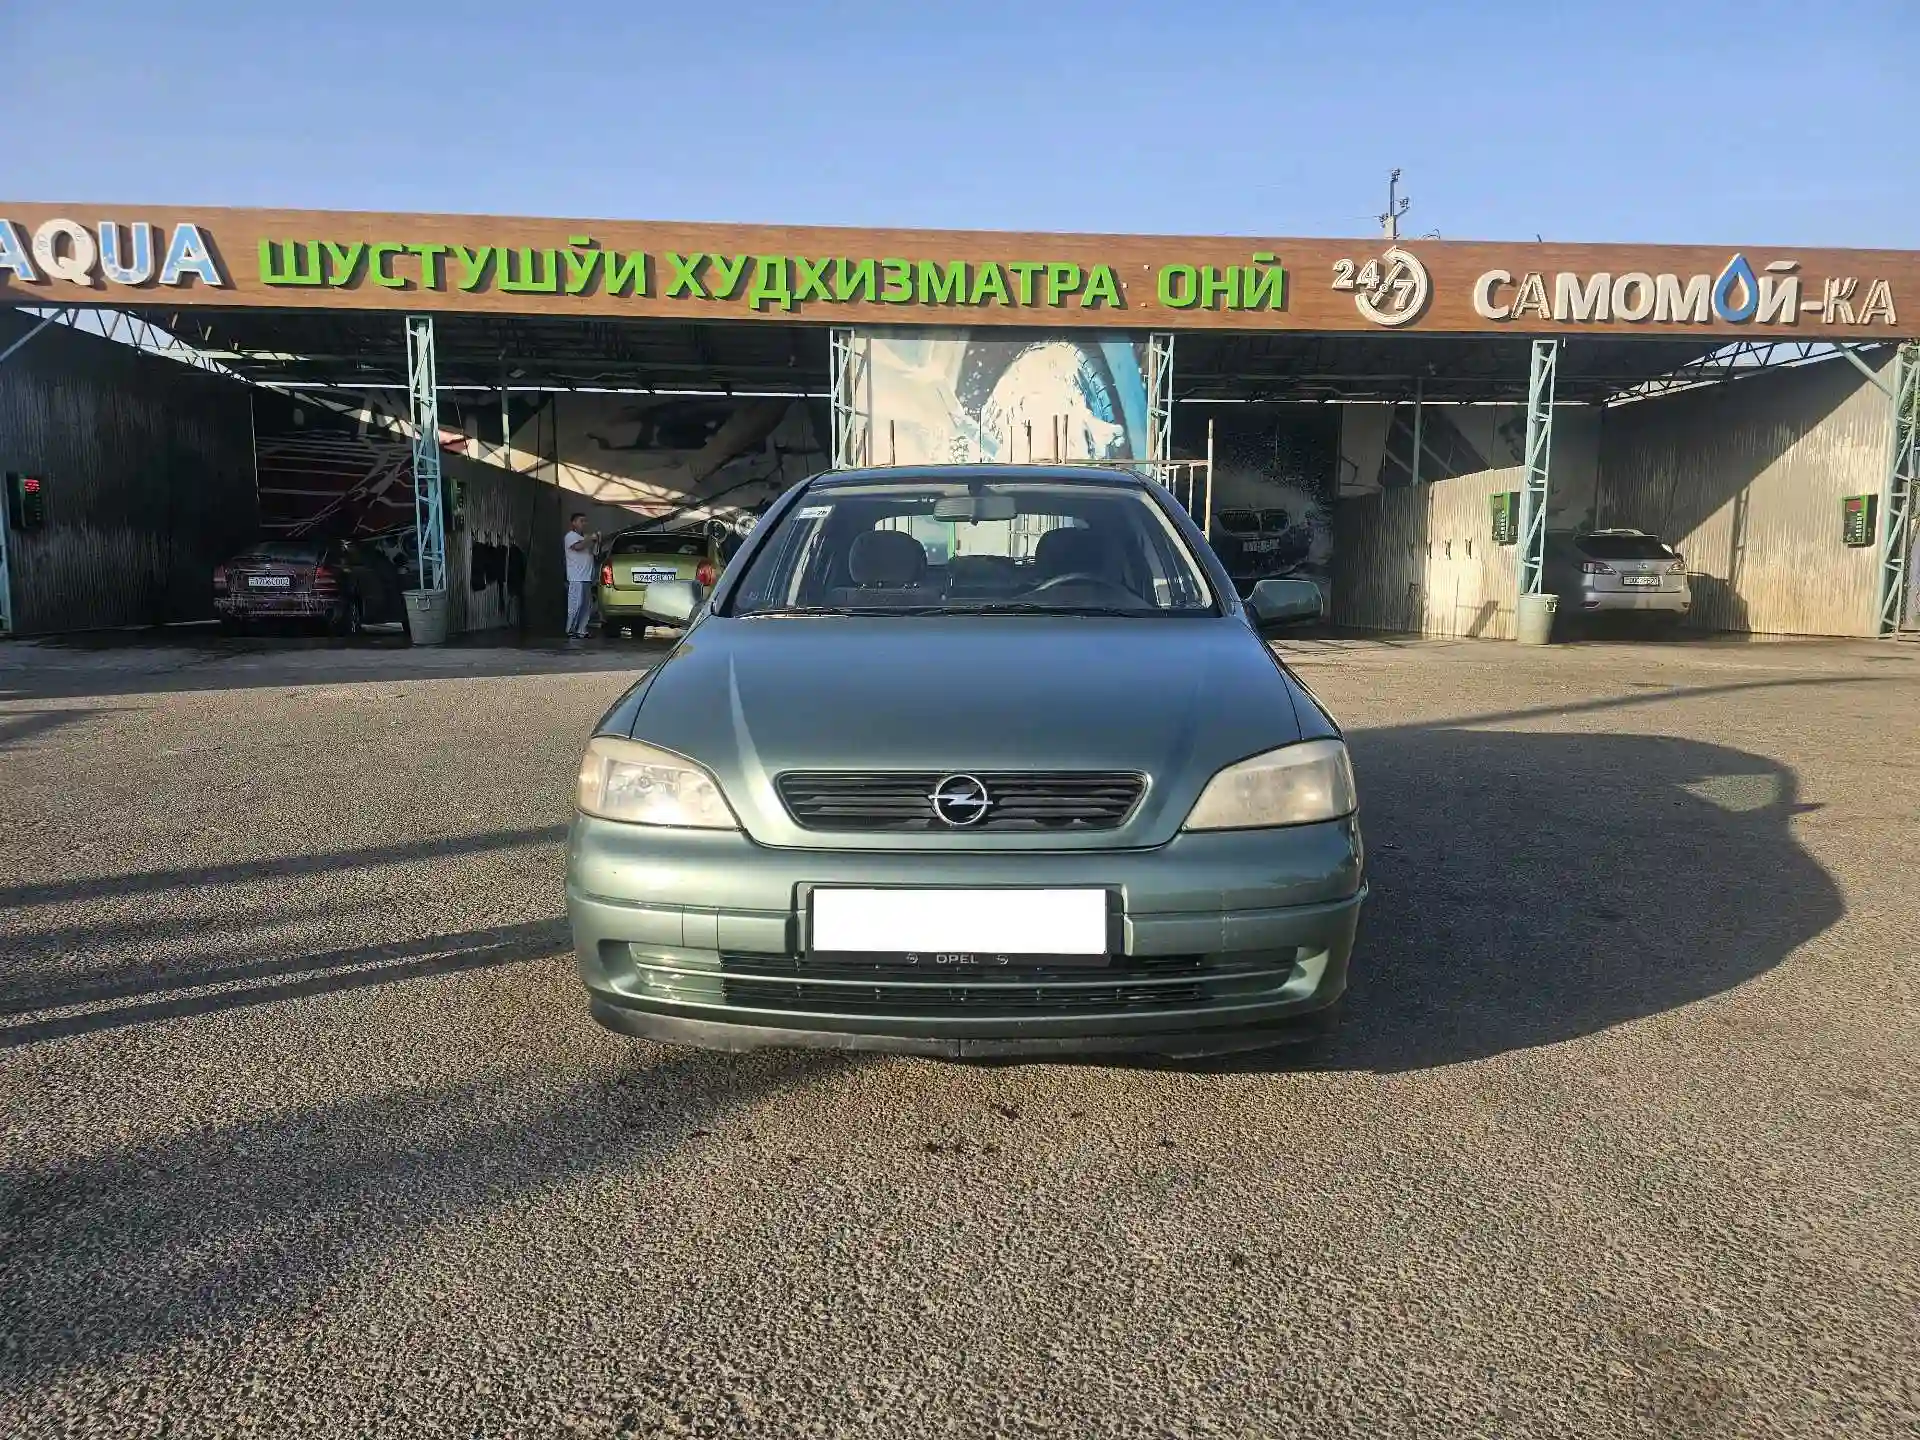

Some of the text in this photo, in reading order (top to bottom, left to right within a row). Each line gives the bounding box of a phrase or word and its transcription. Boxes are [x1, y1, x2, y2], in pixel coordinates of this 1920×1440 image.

[0, 218, 223, 286] AQUA
[665, 252, 1121, 310] ХУДХИЗМАТРА
[936, 954, 979, 964] OPEL
